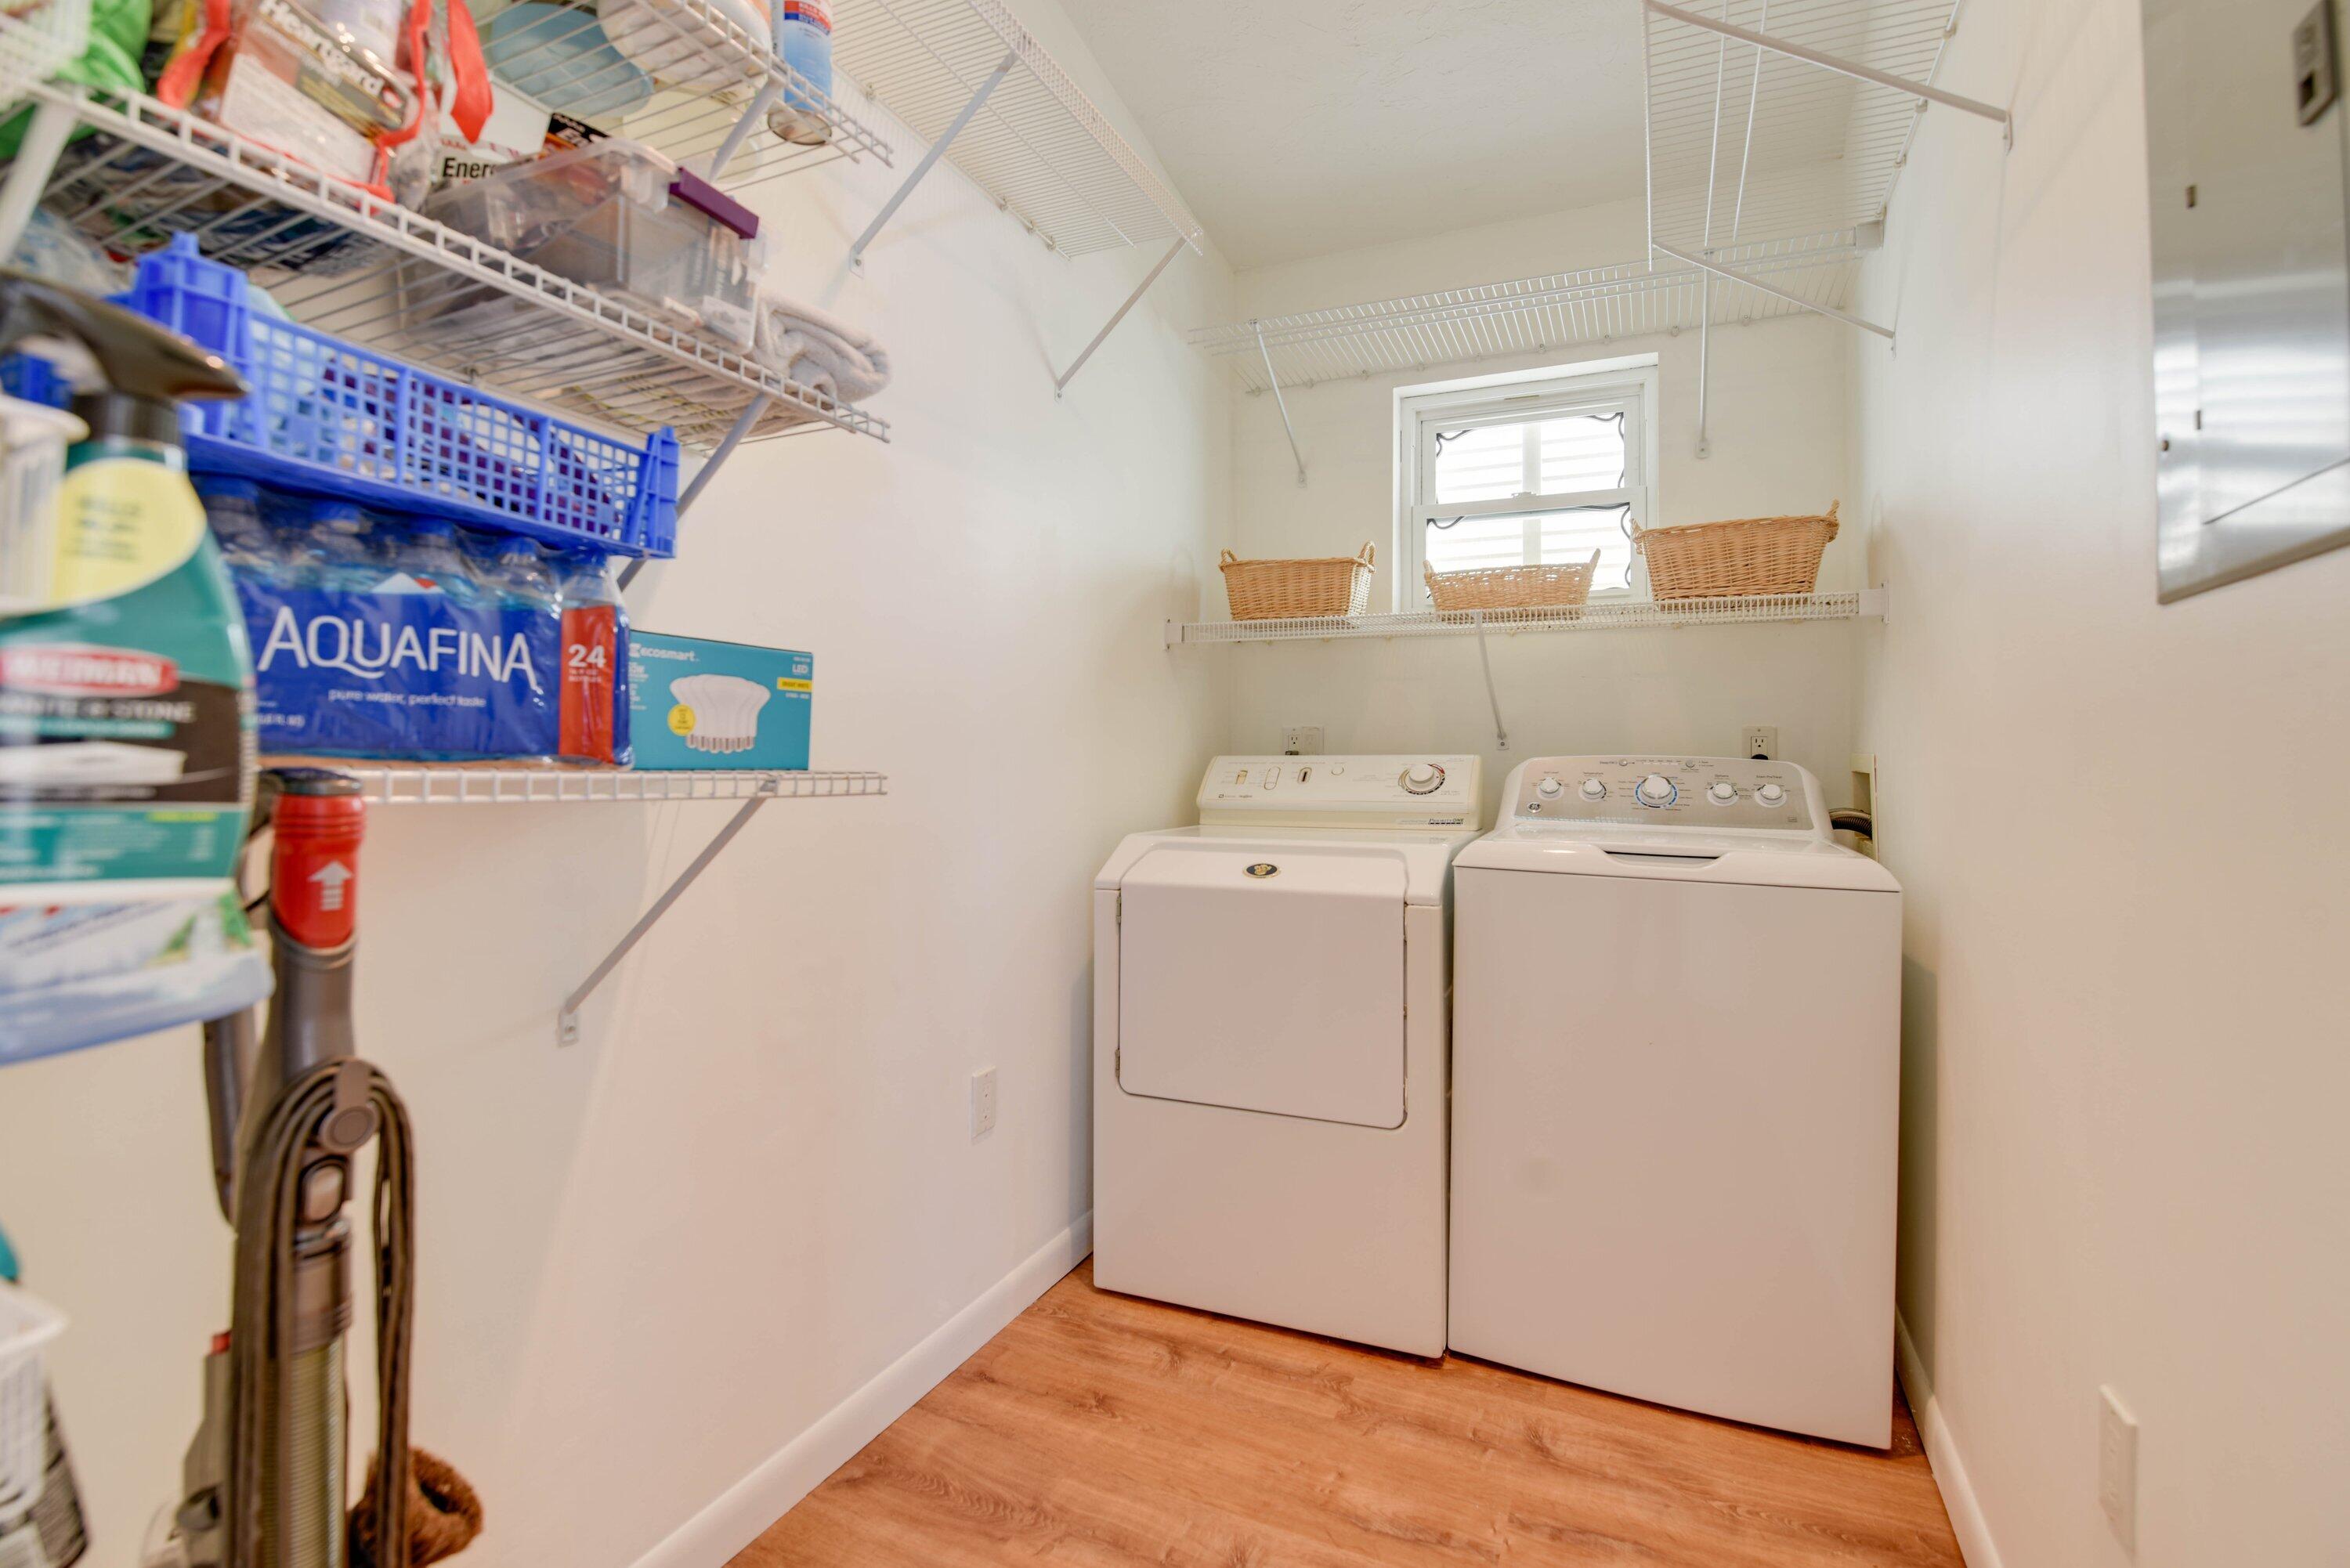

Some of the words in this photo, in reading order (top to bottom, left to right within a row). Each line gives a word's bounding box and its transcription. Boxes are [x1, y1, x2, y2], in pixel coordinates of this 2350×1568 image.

[443, 157, 495, 179] Ener
[258, 605, 538, 689] AQUAFINA
[568, 643, 606, 669] 24
[640, 647, 696, 662] ecosmart
[327, 688, 363, 702] pure
[365, 692, 406, 706] water,
[407, 693, 457, 707] perfect
[457, 695, 487, 707] taste
